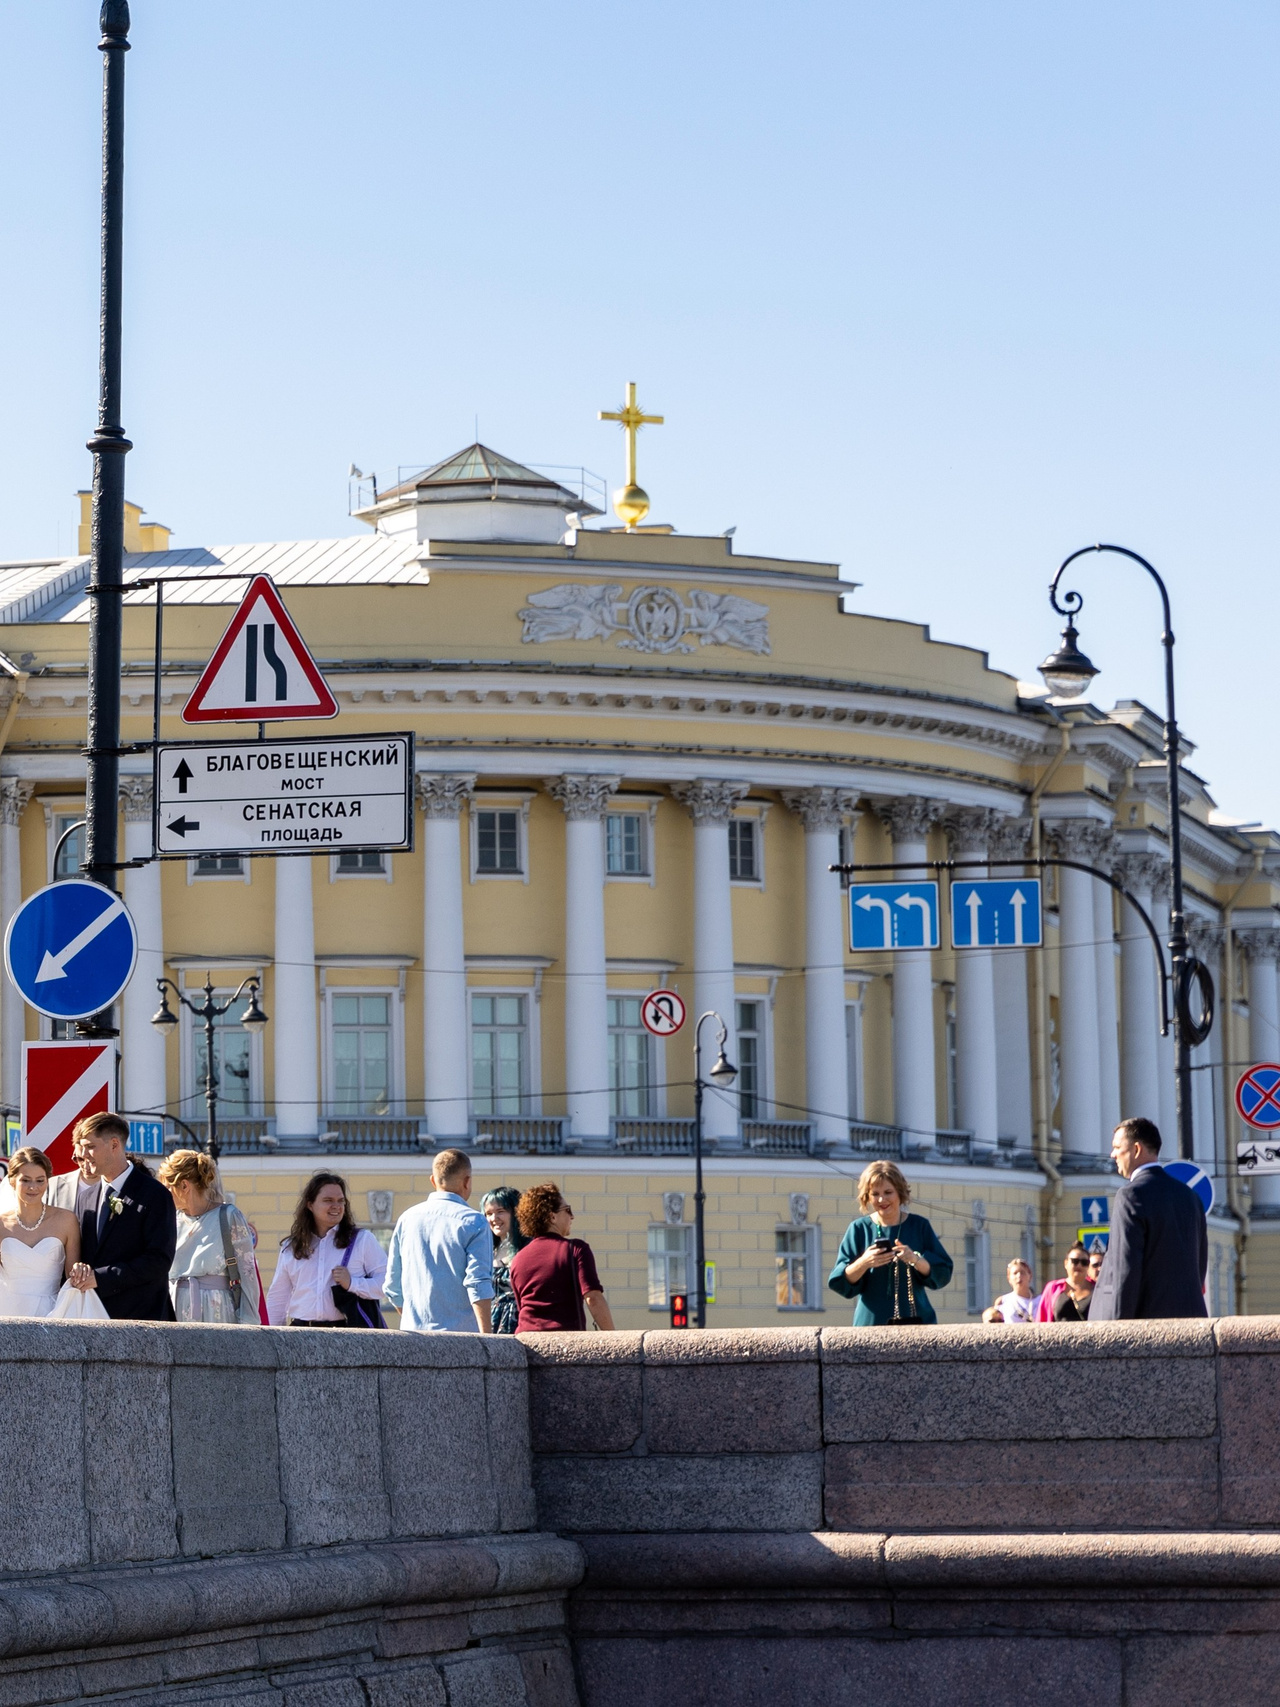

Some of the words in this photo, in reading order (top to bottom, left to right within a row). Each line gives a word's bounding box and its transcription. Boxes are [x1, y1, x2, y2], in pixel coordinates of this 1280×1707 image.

[206, 743, 399, 772] БЛАГОВЕЩЕНСКИЙ
[242, 801, 362, 821] СЕНАТСКАЯ
[261, 827, 343, 842] площадь
